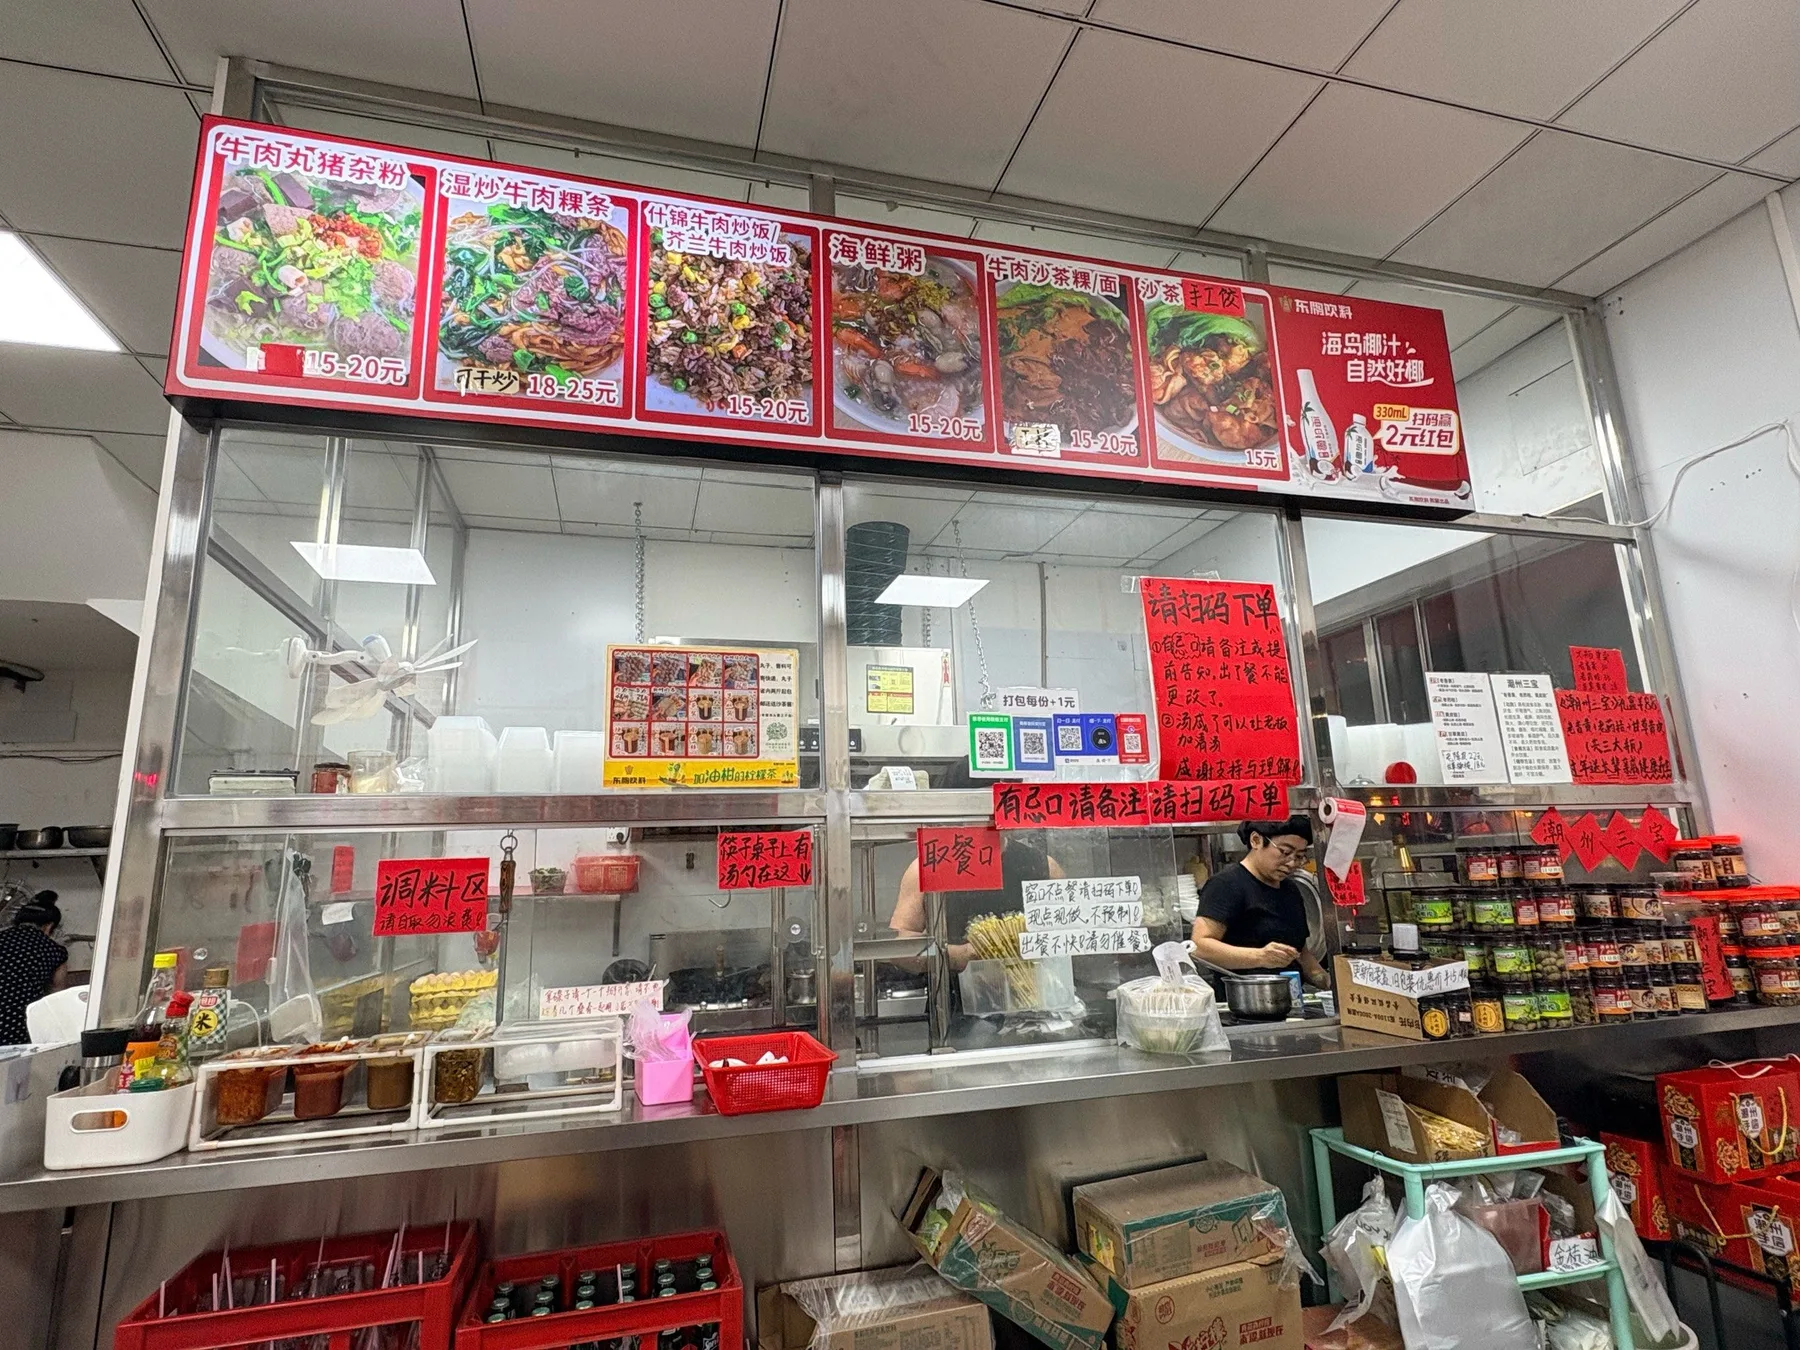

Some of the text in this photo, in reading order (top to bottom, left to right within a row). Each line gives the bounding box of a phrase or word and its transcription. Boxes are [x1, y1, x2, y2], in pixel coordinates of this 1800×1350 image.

[219, 134, 408, 188] 牛肉丸猪杂粉
[442, 171, 612, 218] 湿炒牛肉粿条
[647, 204, 780, 245] 什锦牛肉炒饭/
[665, 230, 790, 265] 芥兰牛肉炒饭
[829, 234, 923, 272] 海鲜粥
[987, 257, 1119, 295] 牛肉沙茶粿/面
[1138, 277, 1182, 305] 沙茶
[1187, 284, 1241, 310] 手工饺
[1321, 332, 1402, 357] 海岛椰汁
[305, 351, 406, 384] 15-20元
[1347, 359, 1425, 384] 自然好椰
[528, 374, 618, 404] 18-25元
[727, 394, 809, 423] 15-20元
[1375, 405, 1408, 419] 330mL
[1411, 412, 1453, 428] 扫码赢
[908, 414, 982, 440] 15-20元
[1385, 424, 1455, 449] 2元红包
[1071, 429, 1138, 456] 15-20元
[1246, 450, 1278, 470] 15元
[1148, 583, 1278, 630] 请扫码下单
[1506, 679, 1540, 689] 潮州三宝
[1002, 694, 1076, 709] 打包每份+1元
[1178, 733, 1222, 754] 加清汤
[693, 767, 778, 785] 加油柑的柠檬茶
[996, 781, 1283, 823] 有忌口请备注 请扫码下单
[720, 833, 810, 861] 筷子桌子上有
[1543, 820, 1665, 855] 潮州三宝
[923, 834, 993, 878] 取餐口
[720, 861, 799, 888] 汤勺在这
[380, 868, 486, 911] 调料区
